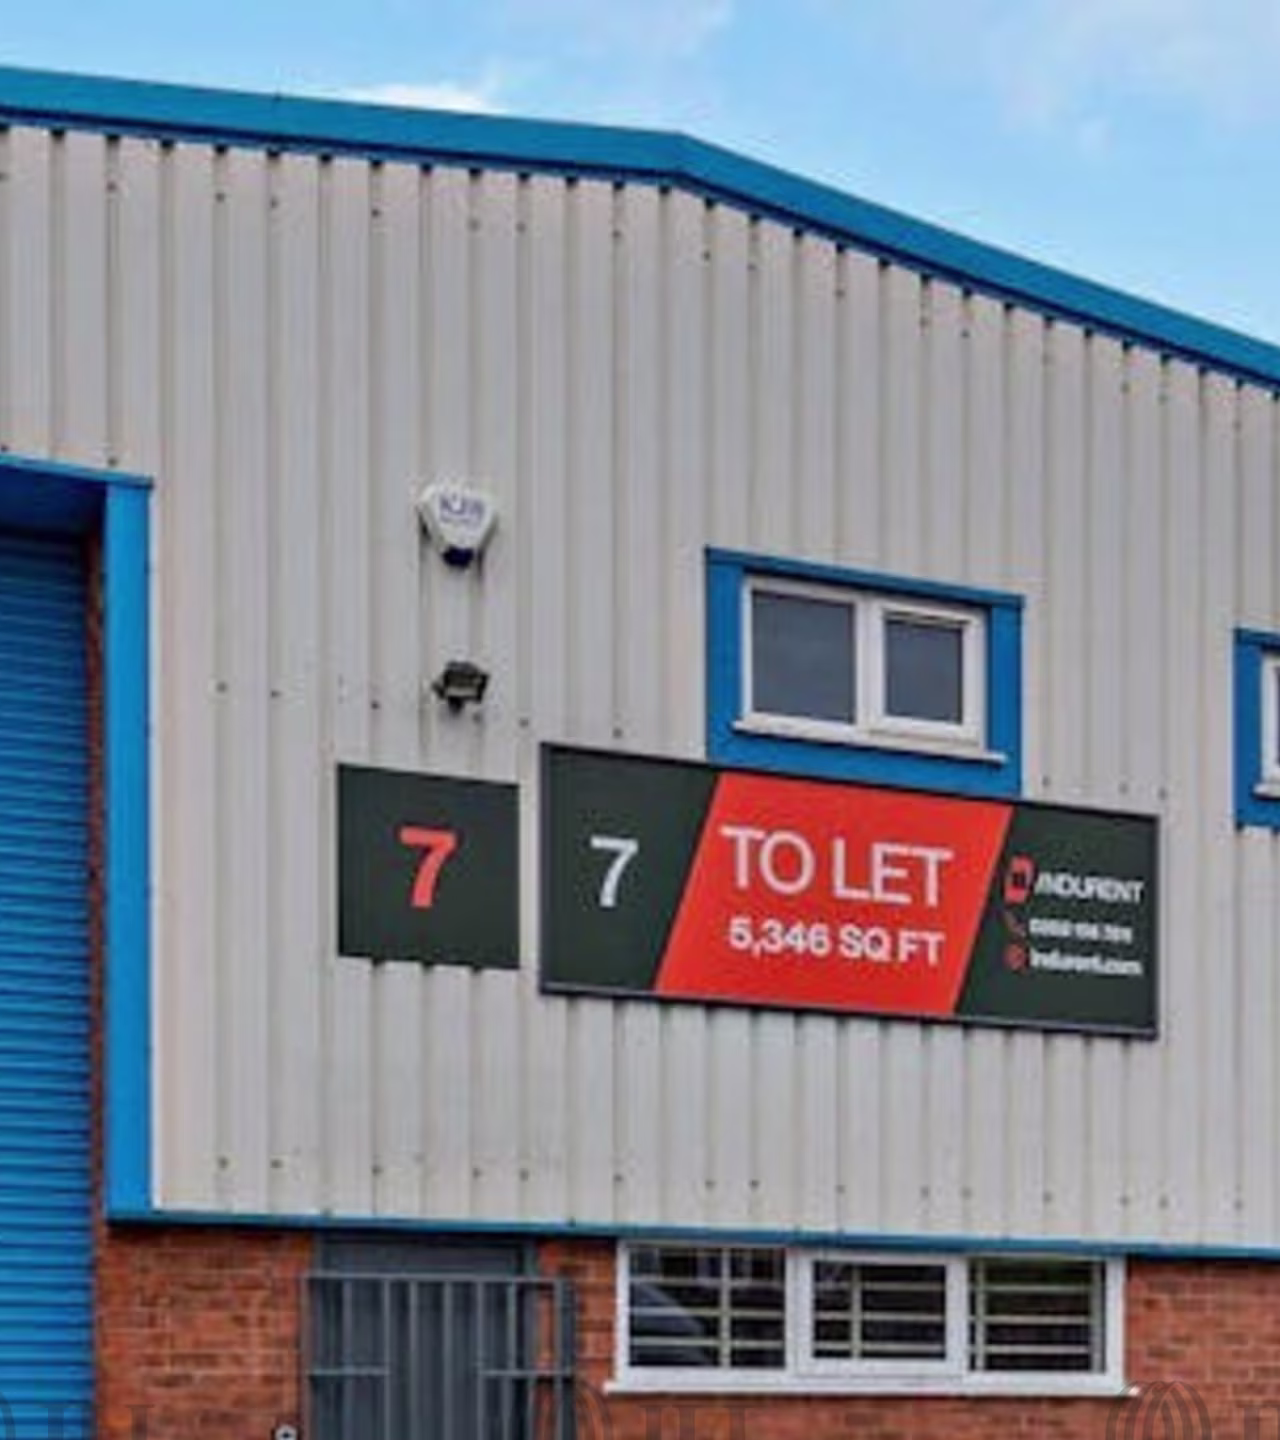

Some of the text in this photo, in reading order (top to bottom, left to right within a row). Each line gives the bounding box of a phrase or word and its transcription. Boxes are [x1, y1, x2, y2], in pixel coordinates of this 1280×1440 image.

[400, 826, 456, 908] 7
[590, 835, 639, 907] 7
[720, 824, 954, 907] TO LET
[729, 916, 945, 967] 5,346 SQ FT
